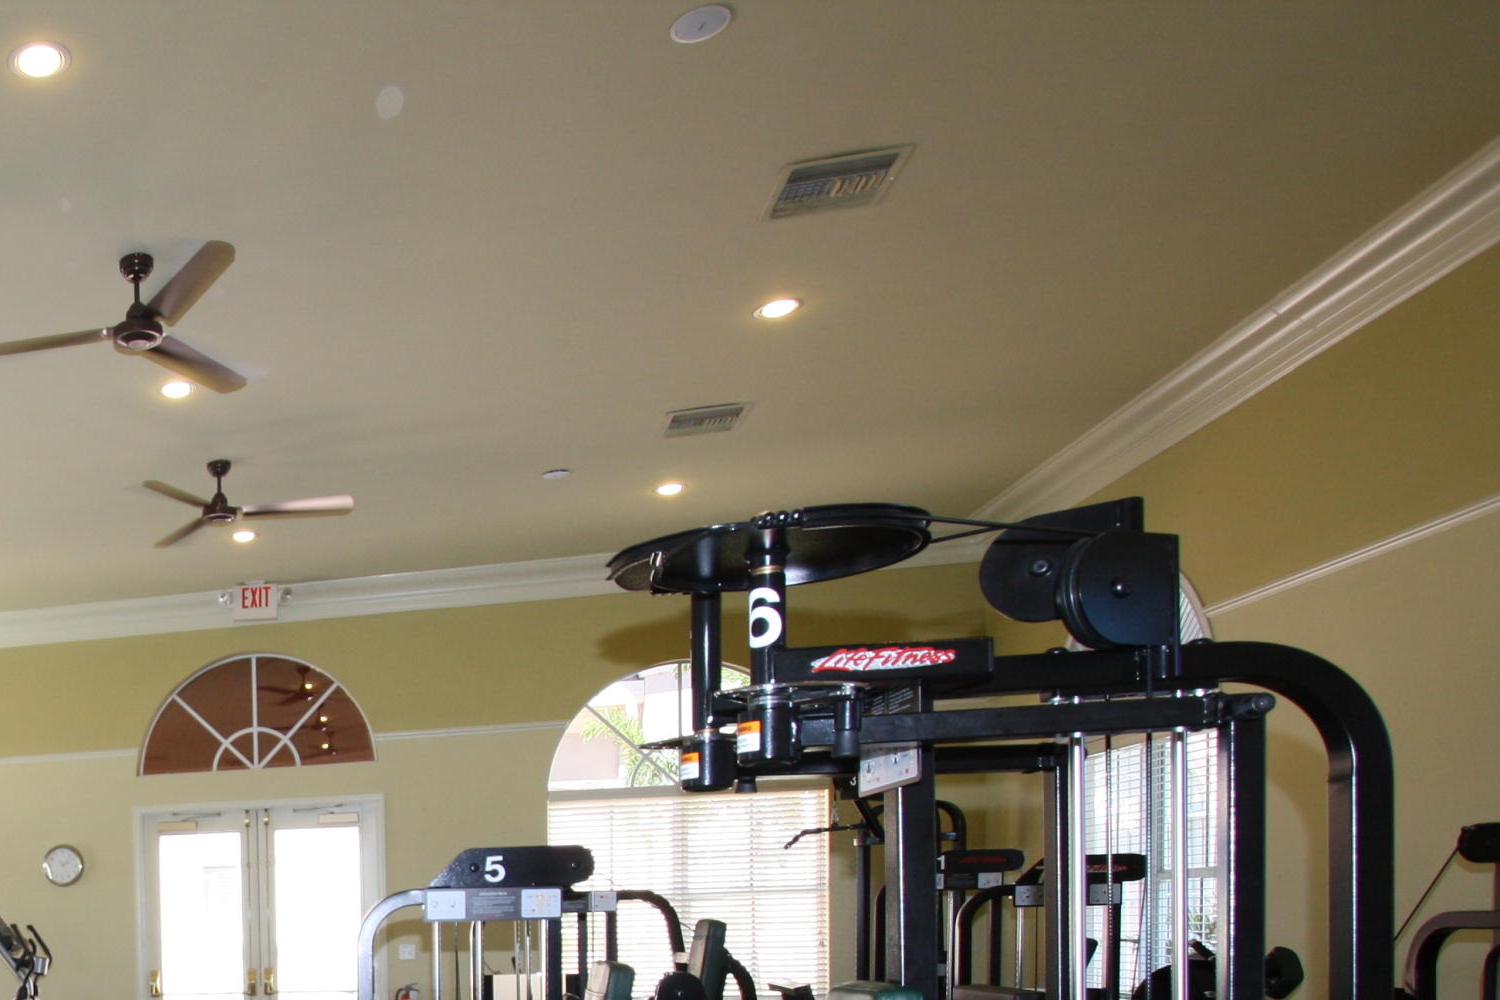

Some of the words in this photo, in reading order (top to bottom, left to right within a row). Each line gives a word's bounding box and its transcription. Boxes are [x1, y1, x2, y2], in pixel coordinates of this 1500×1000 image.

[242, 586, 271, 608] EXIT
[749, 587, 782, 649] 6
[484, 856, 506, 882] 5
